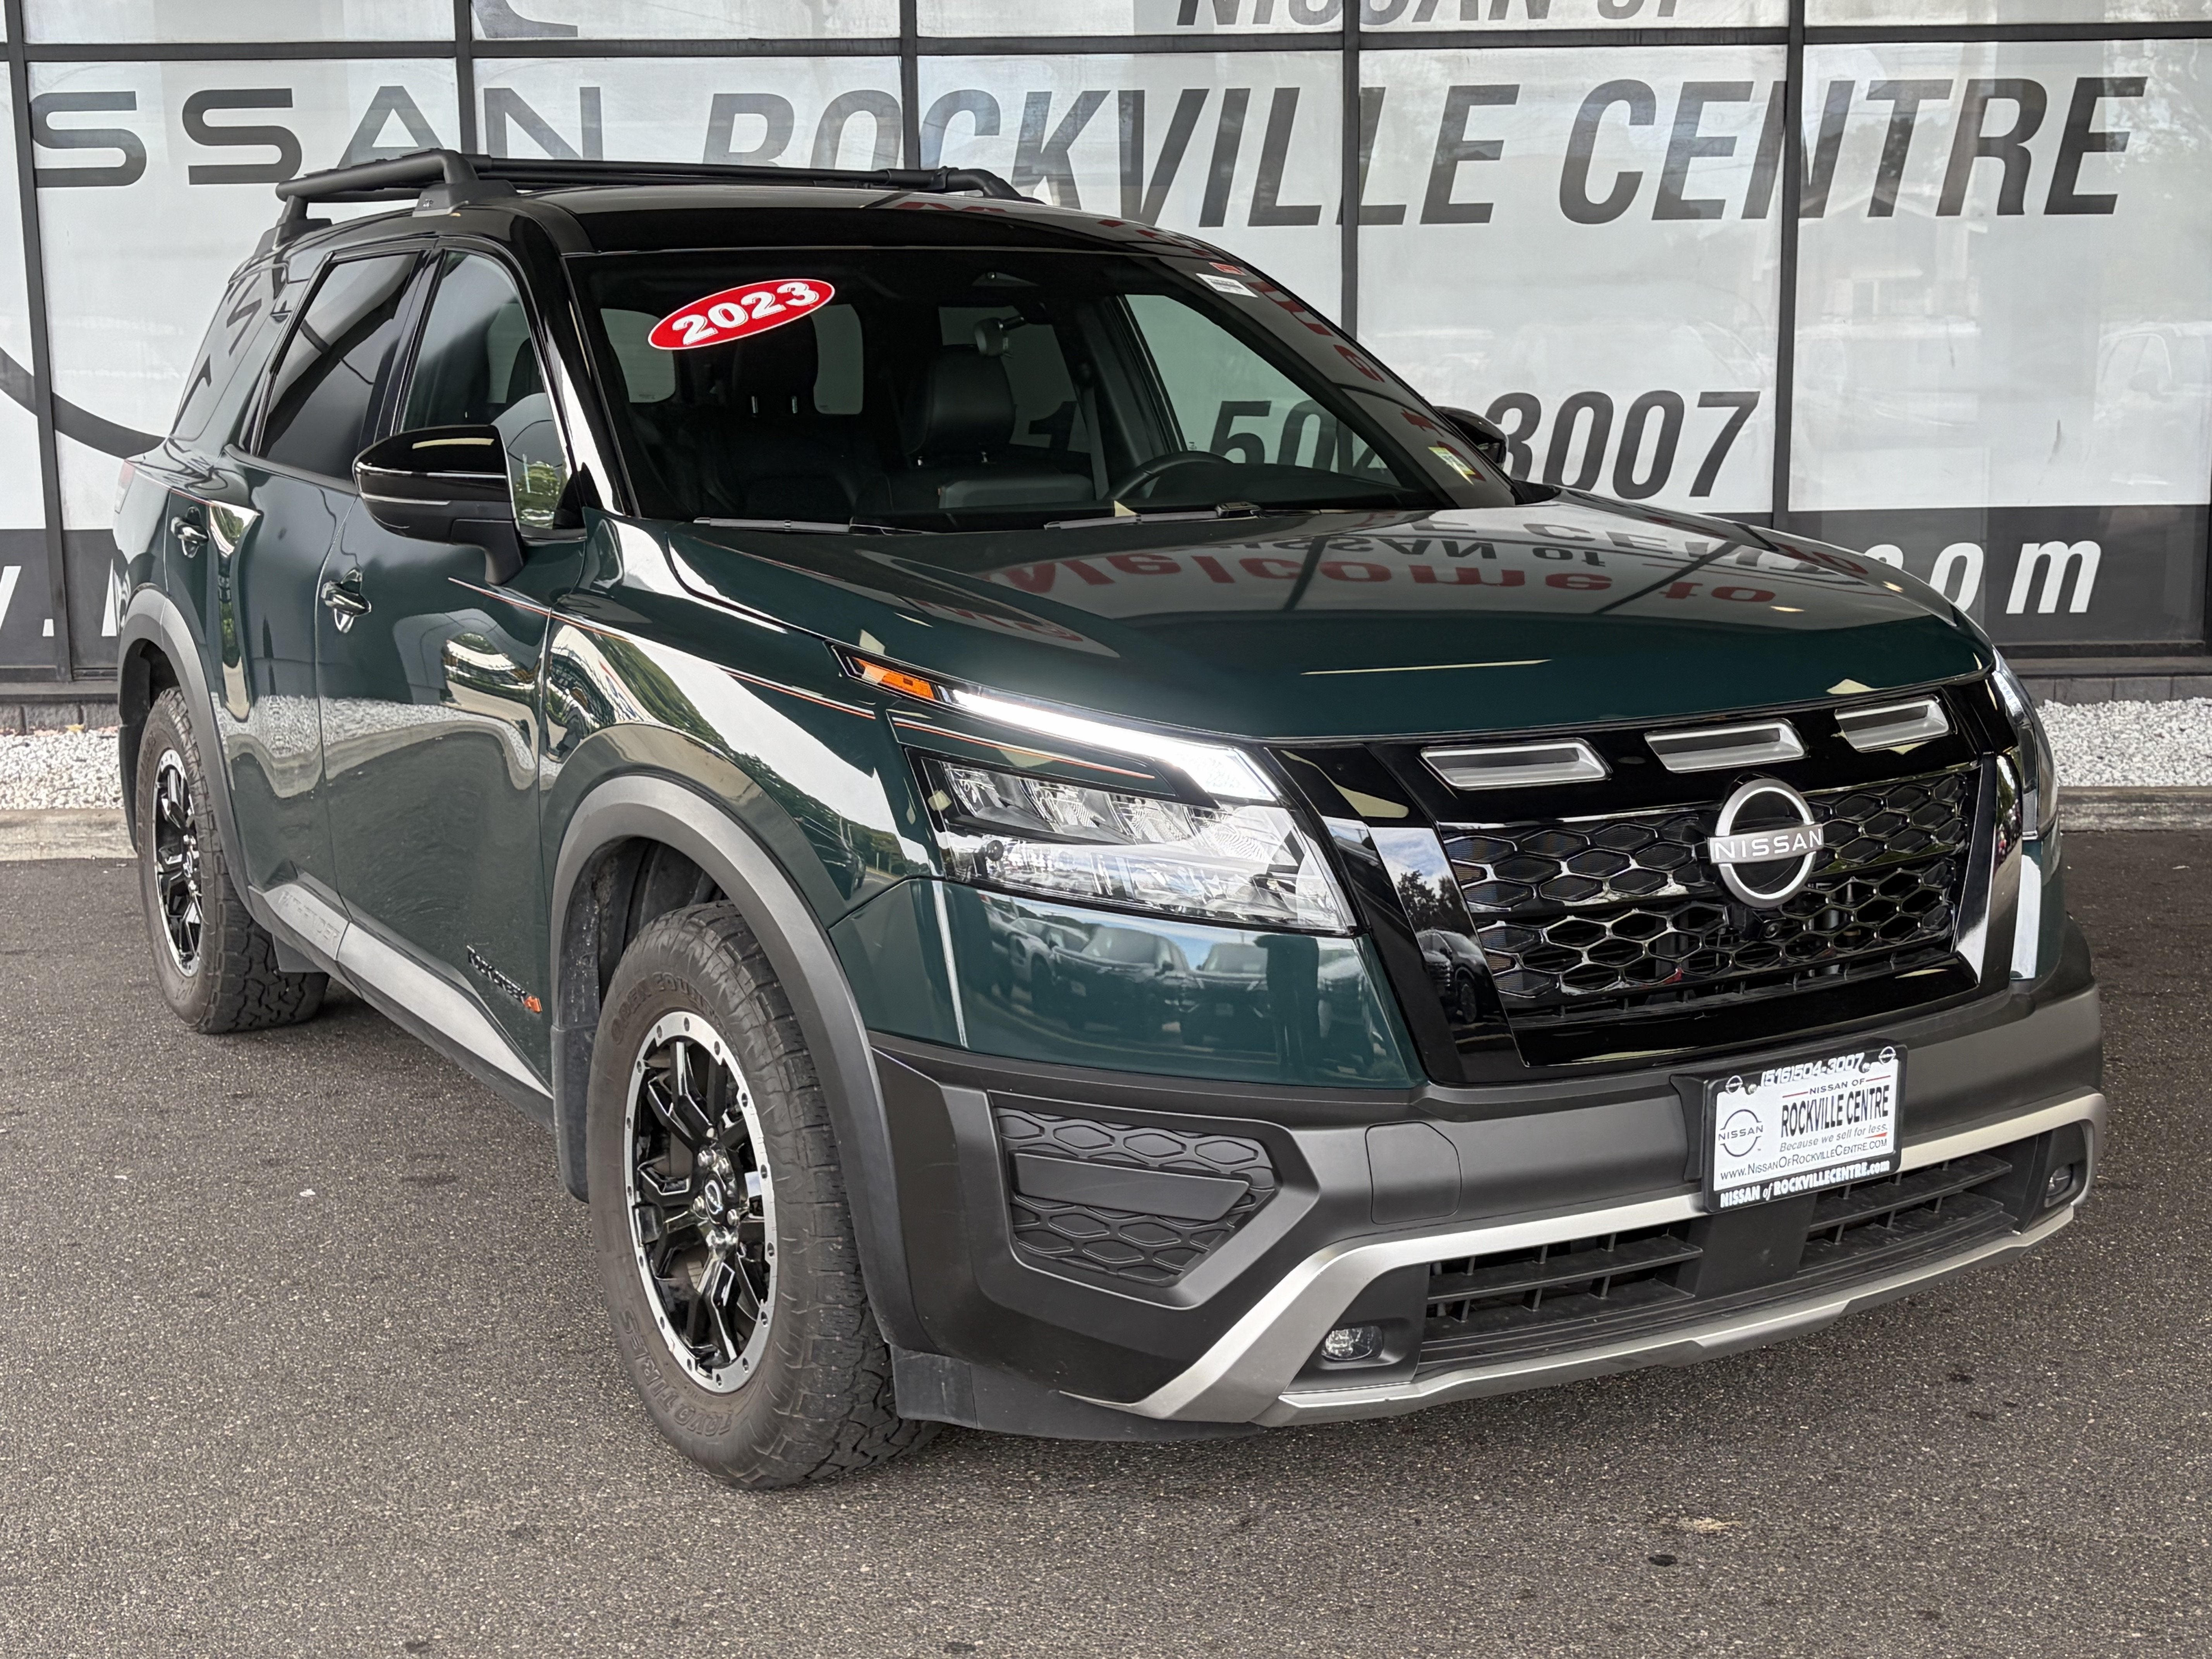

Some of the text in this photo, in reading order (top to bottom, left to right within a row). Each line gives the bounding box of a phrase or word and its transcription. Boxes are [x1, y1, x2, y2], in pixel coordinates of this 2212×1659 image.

[703, 76, 2148, 228] ROCKVILLE CENTRE
[672, 282, 820, 346] 2023
[1714, 828, 1823, 860] NISSAN
[1761, 1053, 1865, 1087] (516)504-3007
[1809, 1077, 1865, 1095] NISSAN OF
[1781, 1085, 1890, 1138] ROCKVILLE CENTRE
[1718, 1125, 1764, 1141] NISSAN
[1779, 1123, 1888, 1152] Because we sell for less.
[1720, 1186, 1760, 1208] NISSAN
[1763, 1183, 1773, 1200] of
[620, 1309, 681, 1413] TIRES
